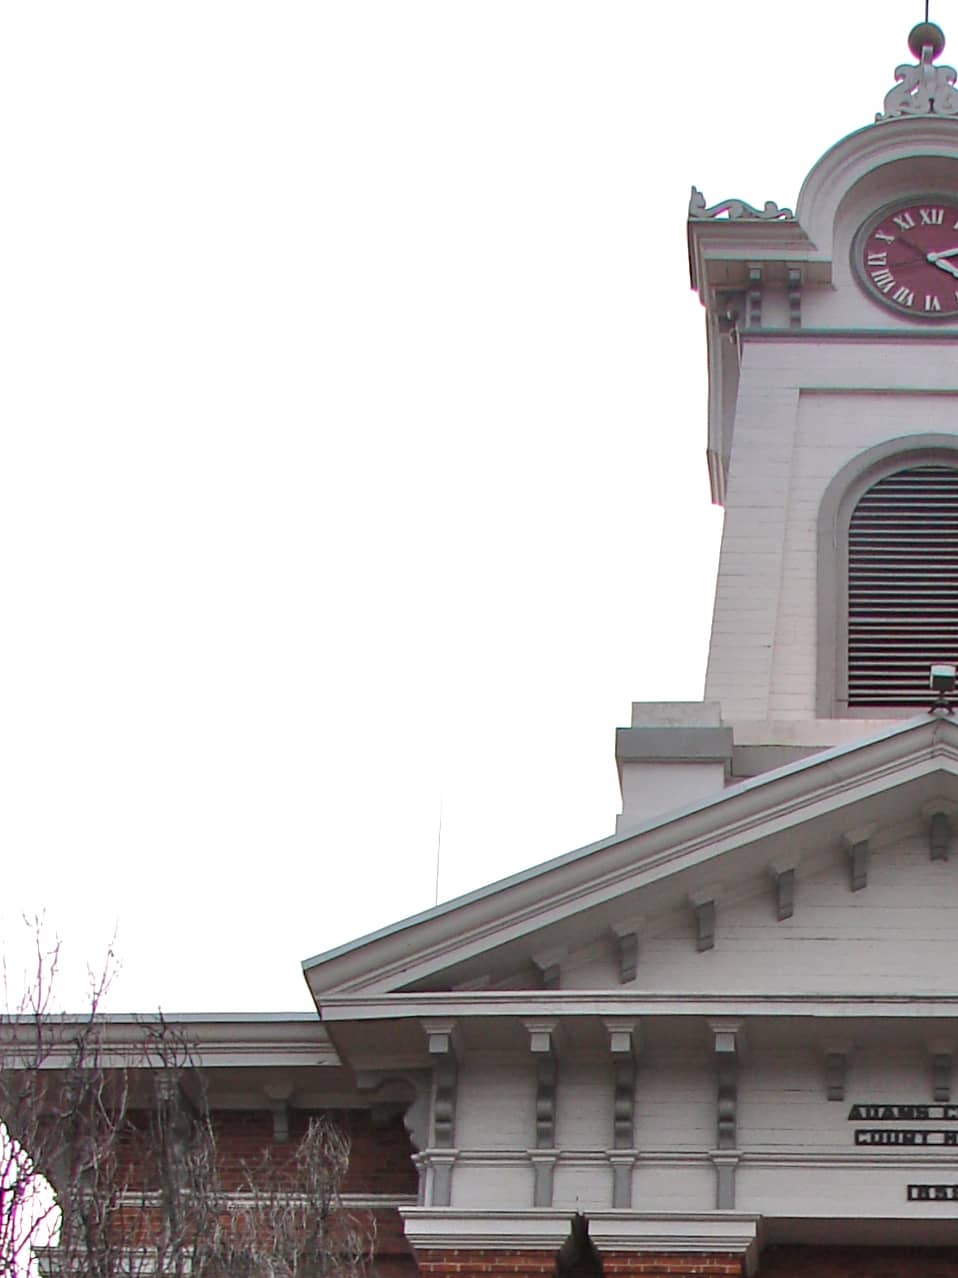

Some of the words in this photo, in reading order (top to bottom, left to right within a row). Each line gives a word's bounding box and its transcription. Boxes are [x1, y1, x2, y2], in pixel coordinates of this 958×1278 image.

[893, 213, 915, 231] XI
[920, 209, 944, 225] XII
[848, 1104, 929, 1120] ADAMS
[855, 1130, 928, 1146] COURT
